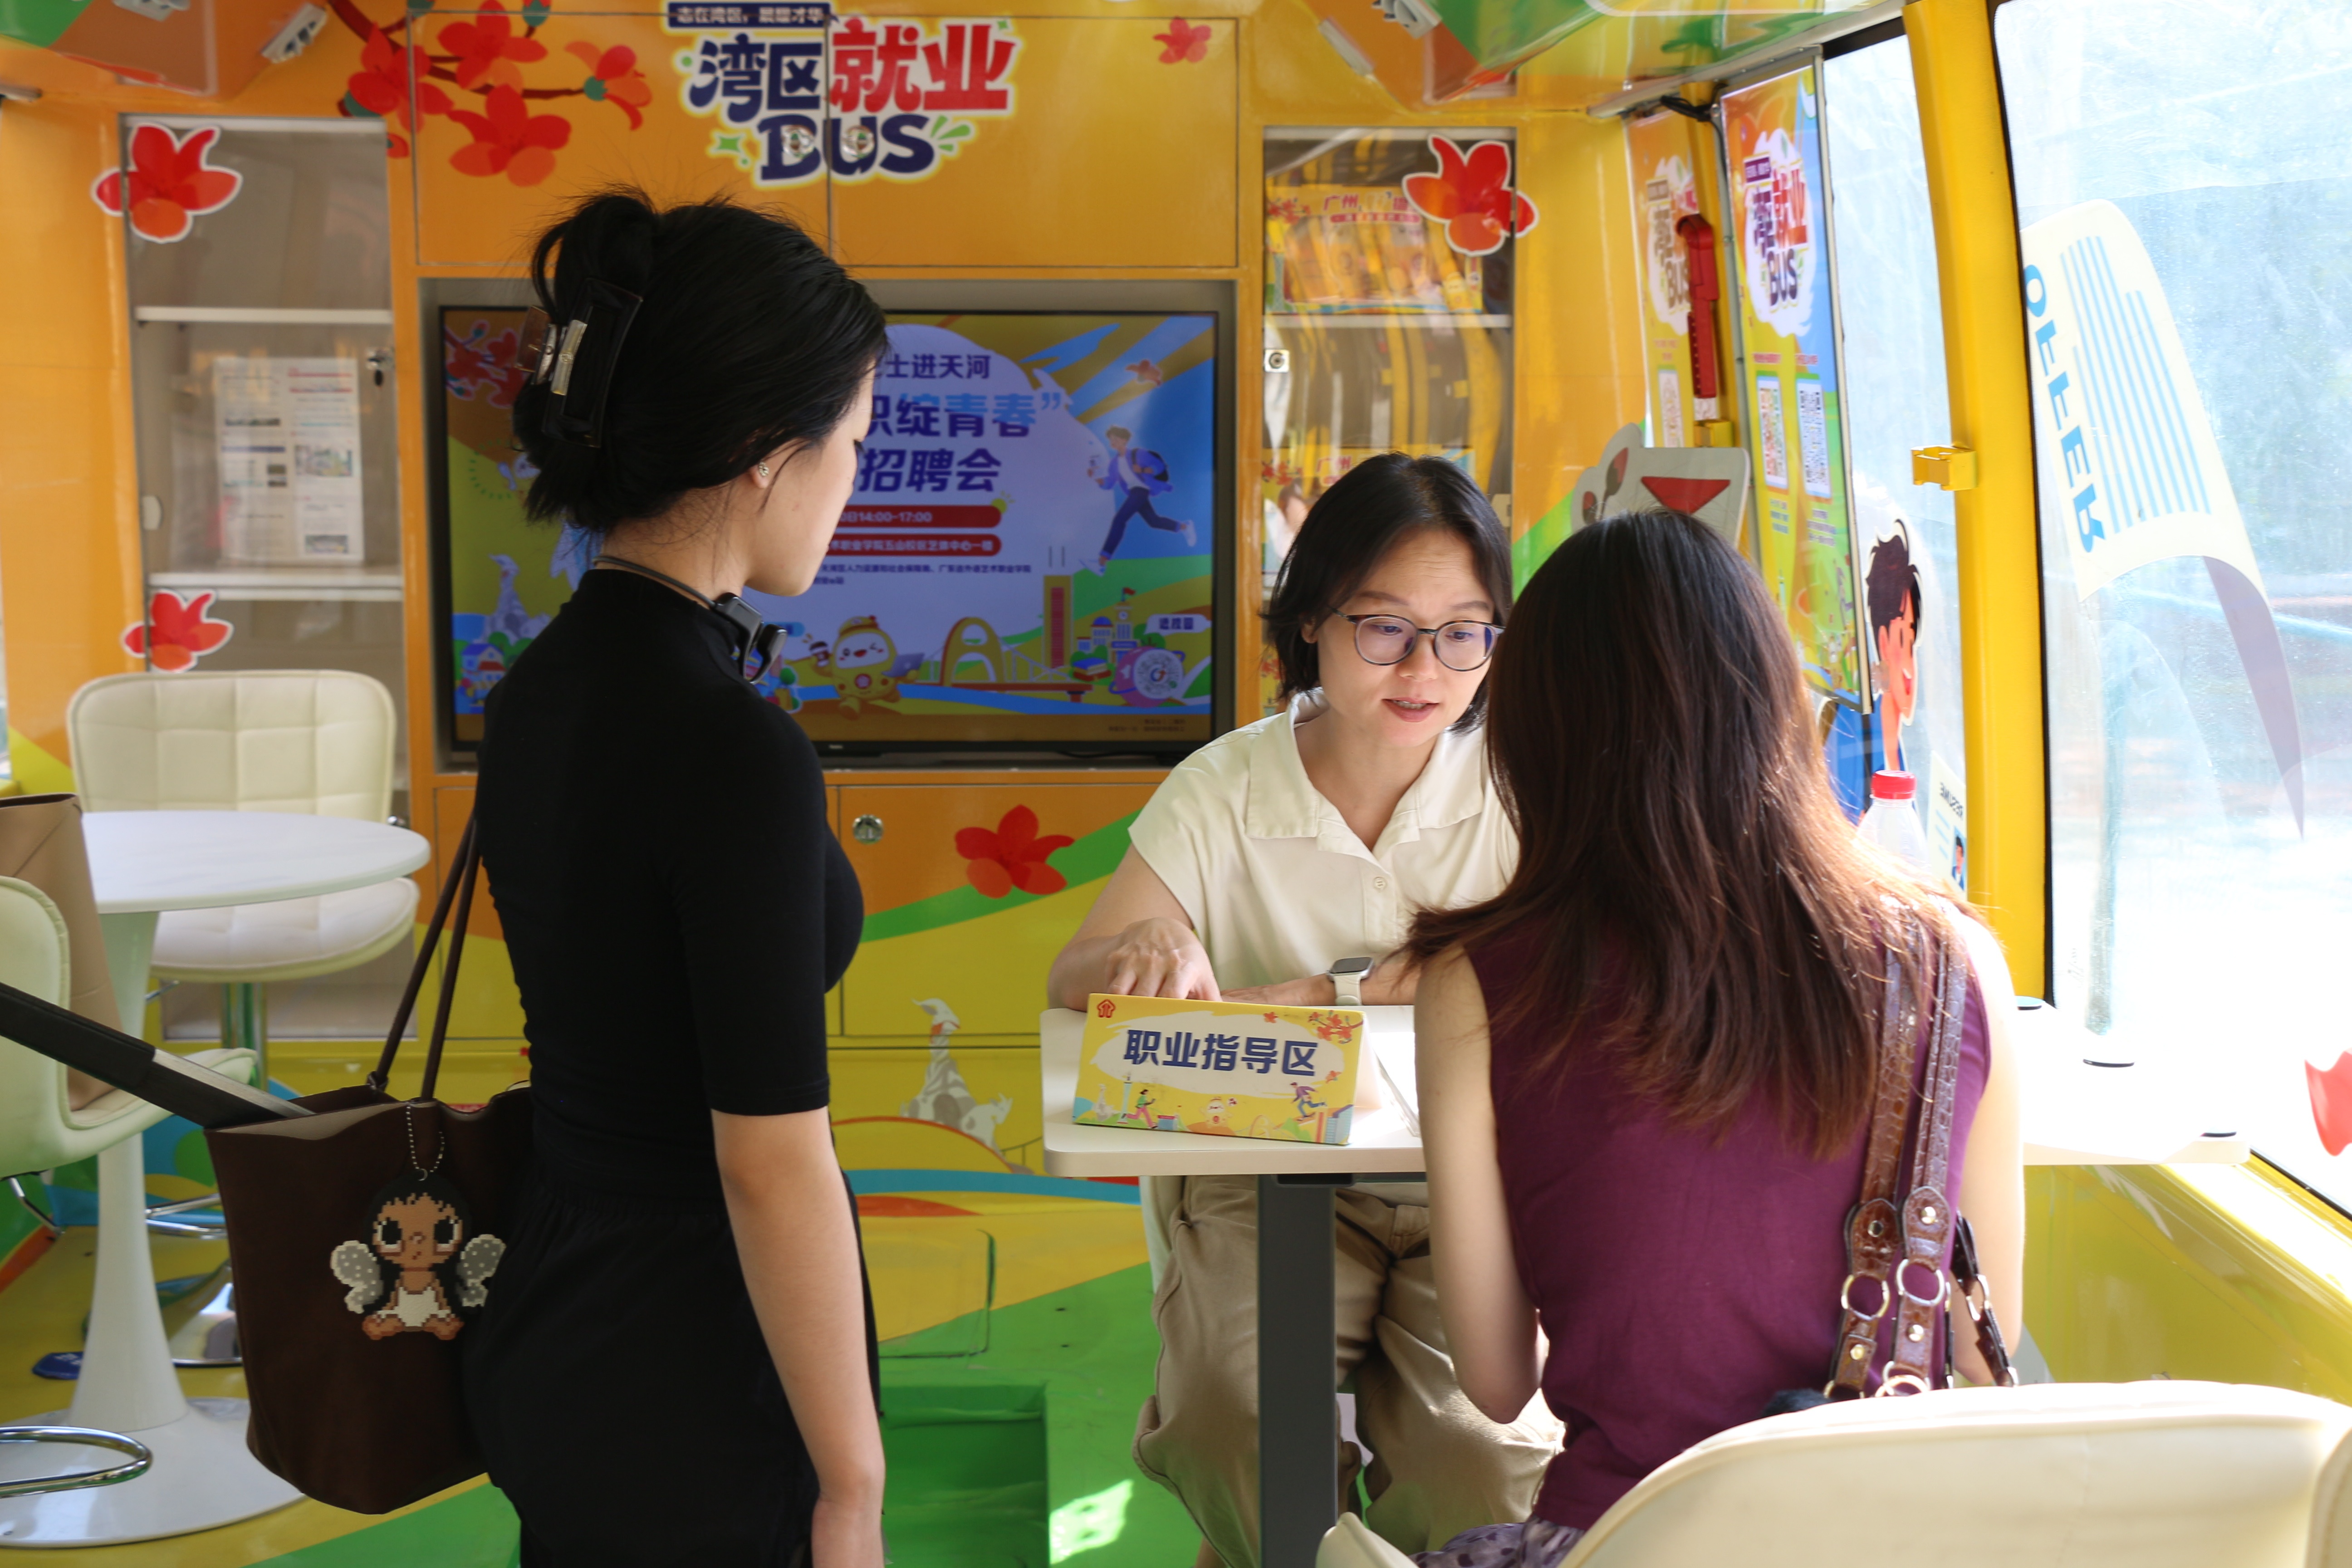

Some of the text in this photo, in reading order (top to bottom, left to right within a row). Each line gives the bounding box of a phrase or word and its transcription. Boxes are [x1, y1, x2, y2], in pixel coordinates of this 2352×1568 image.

[689, 17, 1017, 122] 湾区就业
[757, 114, 935, 180] BUS
[1768, 249, 1797, 306] BUS
[874, 353, 991, 379] 士进天河
[858, 448, 1001, 492] 招聘会
[1123, 1029, 1319, 1077] 职业指导区
